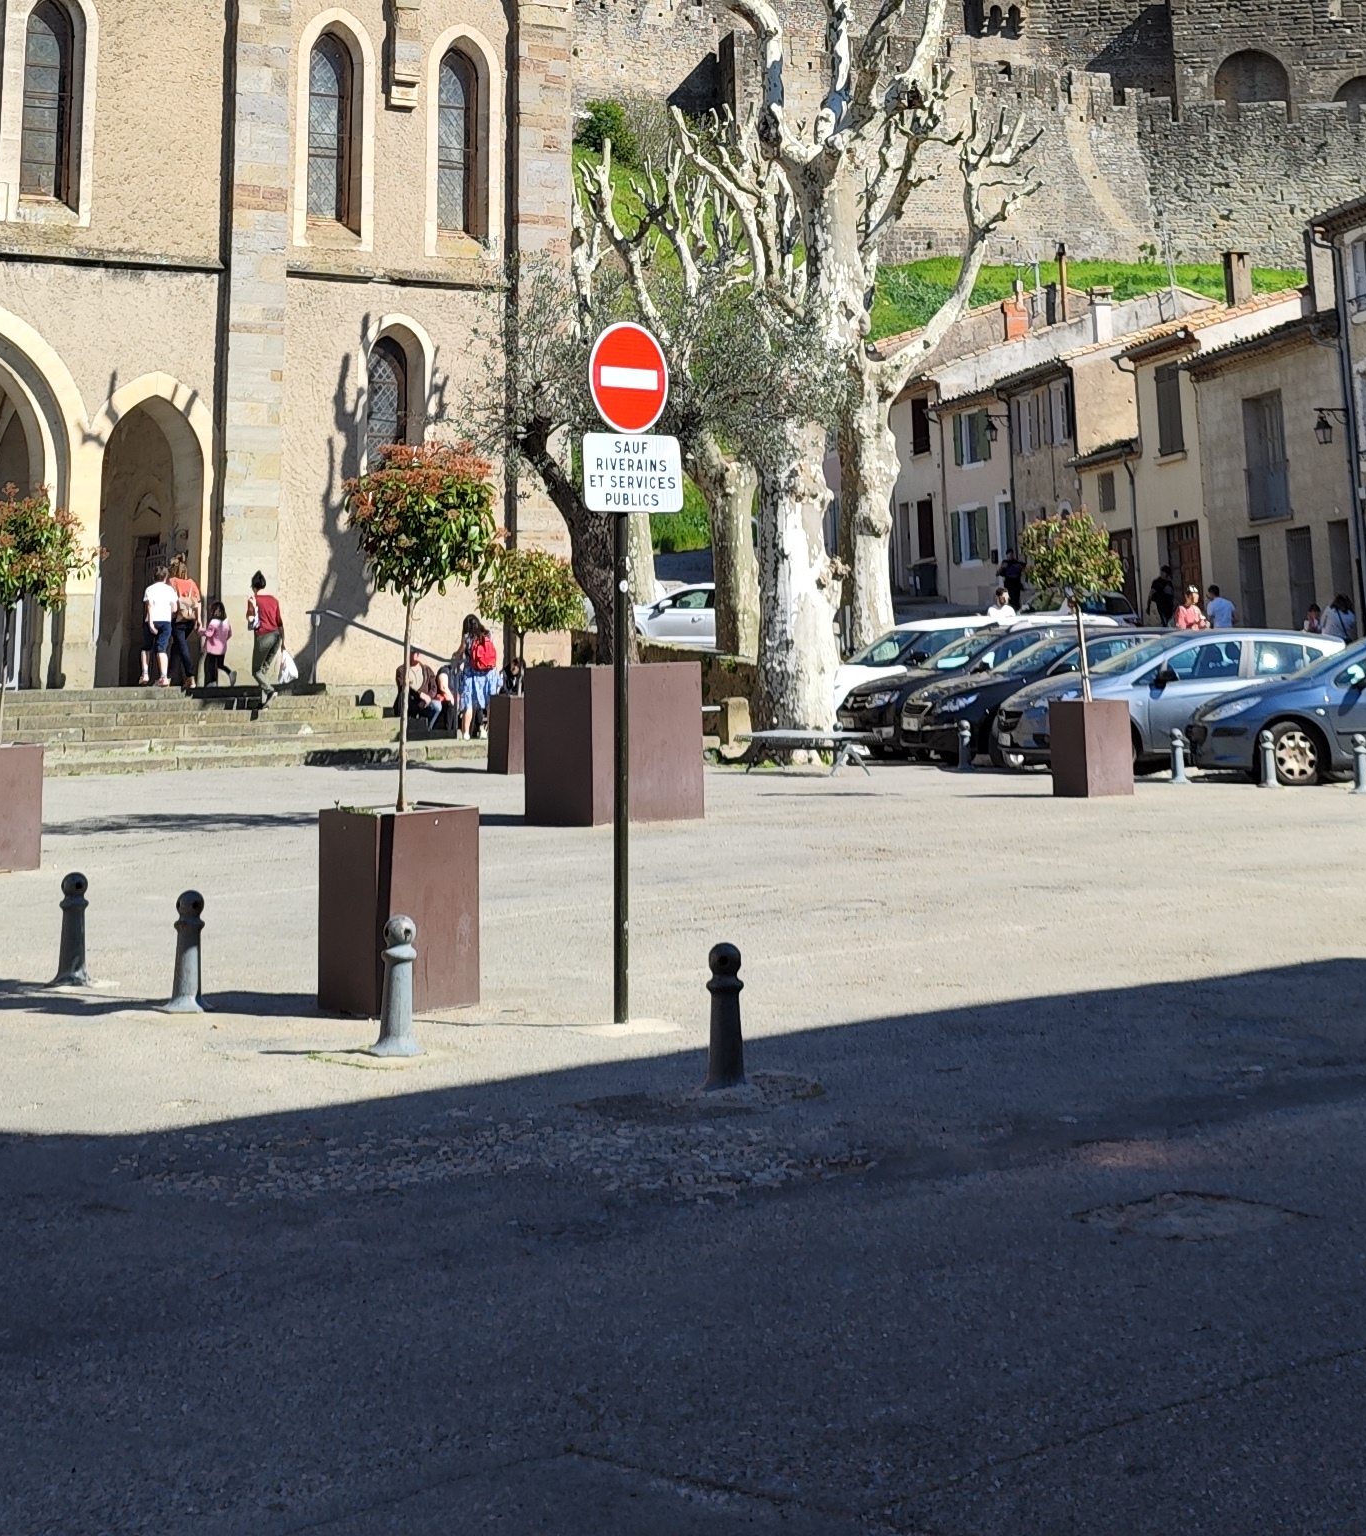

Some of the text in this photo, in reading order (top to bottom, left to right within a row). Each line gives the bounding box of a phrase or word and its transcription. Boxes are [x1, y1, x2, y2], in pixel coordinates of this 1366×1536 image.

[614, 441, 648, 455] SAUF
[596, 457, 667, 472] RIVERAINS
[590, 474, 676, 490] ET SERVICES
[605, 492, 659, 506] PUBLICS
